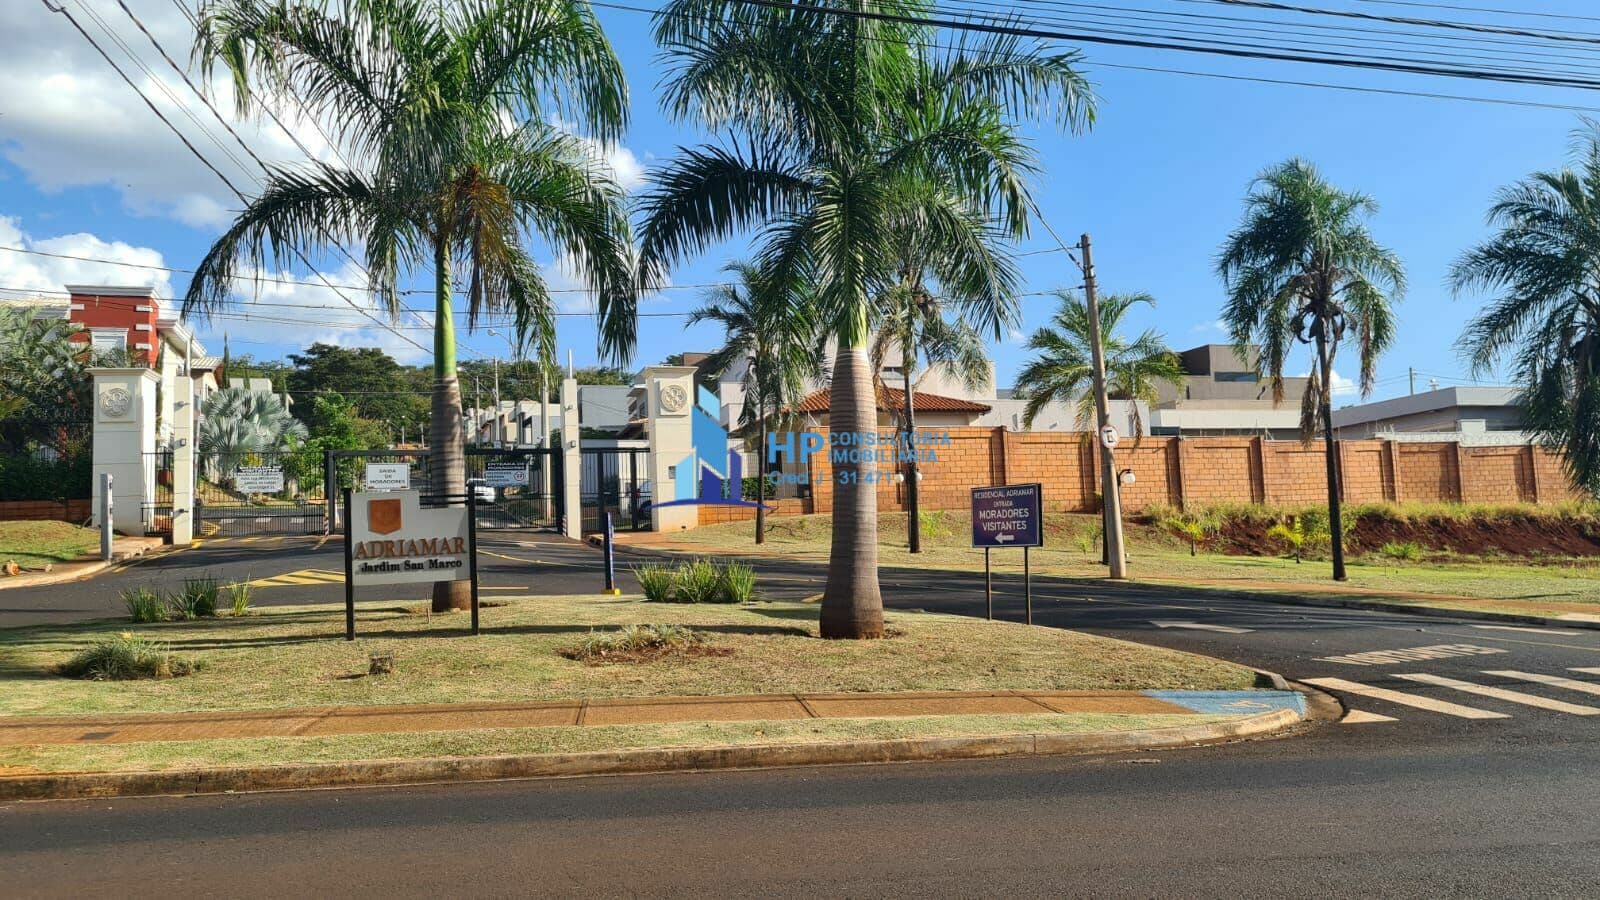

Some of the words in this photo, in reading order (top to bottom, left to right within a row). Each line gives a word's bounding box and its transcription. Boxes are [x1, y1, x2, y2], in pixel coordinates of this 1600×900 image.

[979, 508, 1029, 520] MORADORES
[982, 520, 1027, 531] VISITANTES
[355, 537, 467, 559] ADRIAMAR
[361, 561, 400, 573] Jardim
[403, 559, 424, 570] San
[428, 558, 463, 569] Marco
